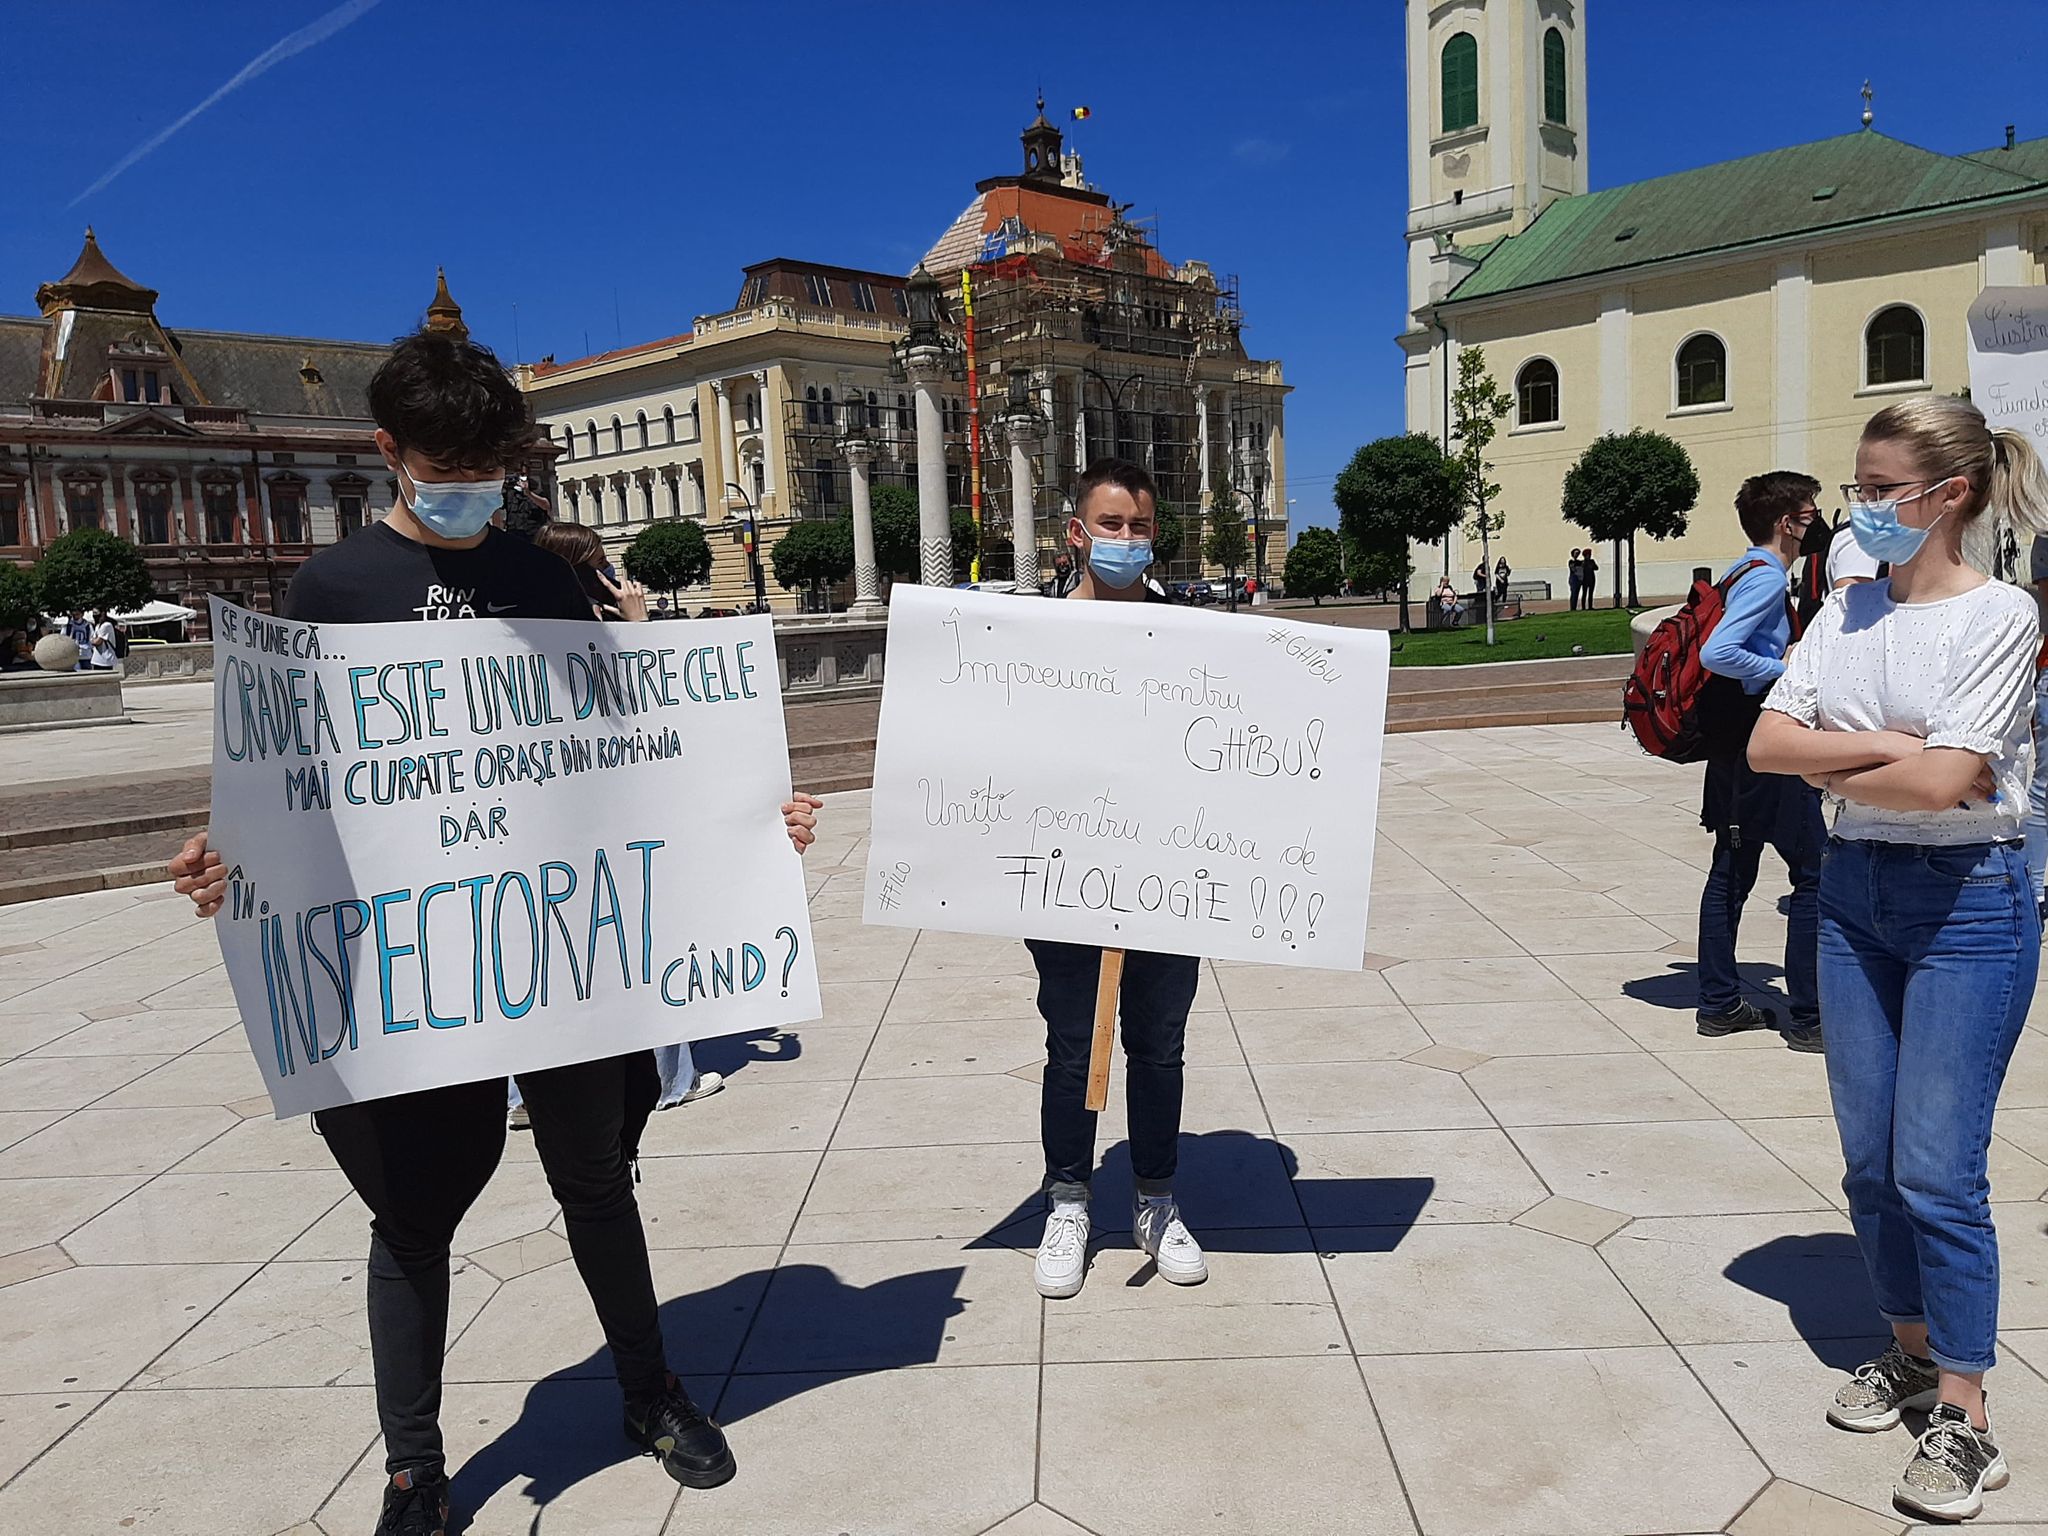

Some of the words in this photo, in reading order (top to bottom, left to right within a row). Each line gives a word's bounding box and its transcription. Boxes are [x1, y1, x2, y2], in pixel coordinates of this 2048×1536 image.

[427, 584, 476, 606] RUN
[458, 604, 476, 619] A
[221, 606, 238, 644] SE
[243, 615, 290, 657] SPUNE
[1266, 628, 1342, 685] #GHIBU
[939, 607, 1122, 706] Împreună
[1136, 664, 1244, 717] pentru
[222, 655, 342, 763] ORADEA
[348, 659, 449, 750] ESTE
[461, 653, 564, 735] UNUL
[566, 642, 680, 721] DINTRE
[683, 640, 758, 703] CELE
[285, 760, 332, 812] MAI
[344, 750, 465, 806] CURATE
[559, 734, 593, 777] DIN
[596, 726, 683, 769] ROMÂNIA
[1184, 716, 1324, 780] GHIBU!
[439, 803, 510, 850] DAR
[1025, 787, 1142, 852] pentru
[1159, 806, 1262, 861] clasa
[1279, 826, 1318, 876] de
[228, 864, 256, 921] ÎN
[259, 840, 665, 1078] INSPECTORAT
